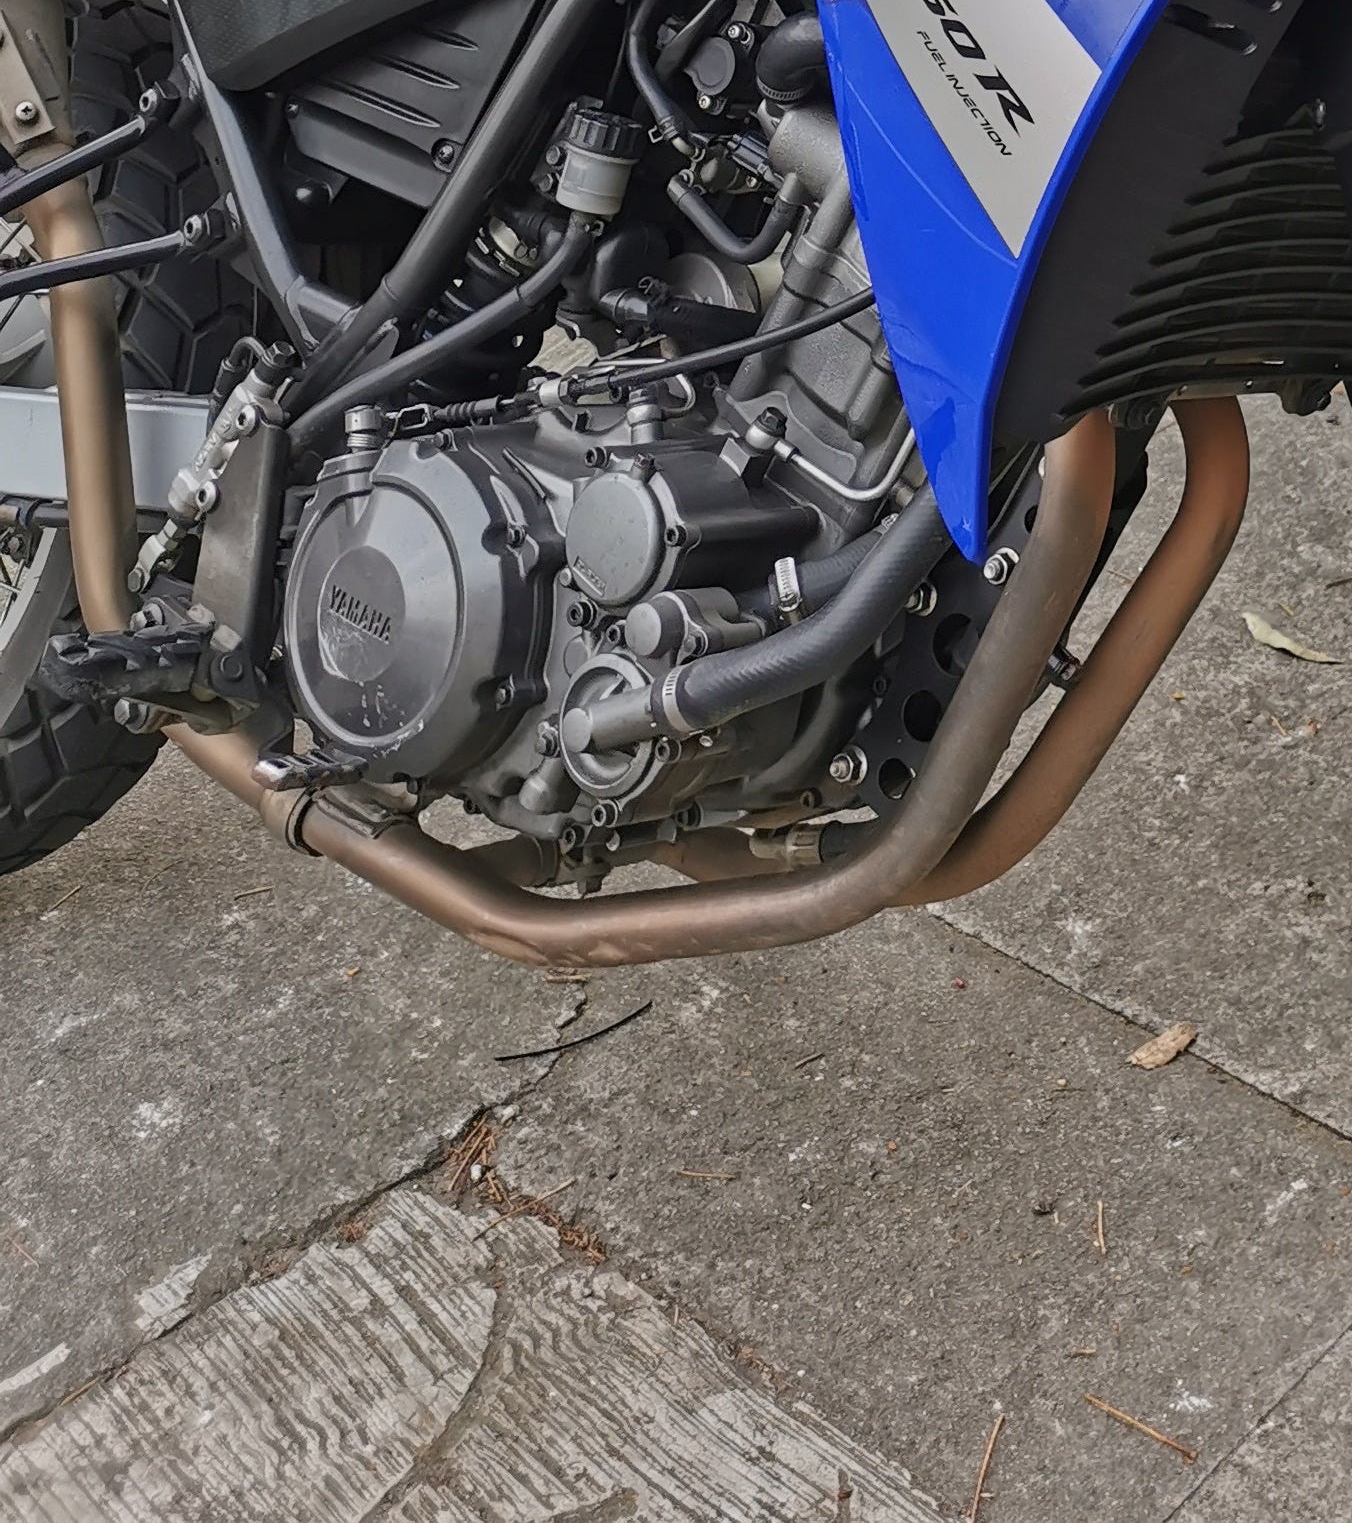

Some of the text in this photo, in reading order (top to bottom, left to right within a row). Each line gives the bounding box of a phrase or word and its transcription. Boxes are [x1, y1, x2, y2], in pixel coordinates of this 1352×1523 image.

[916, 31, 1013, 156] FUEL INJECTION
[973, 64, 1035, 138] R
[330, 585, 391, 641] YAMAHA
